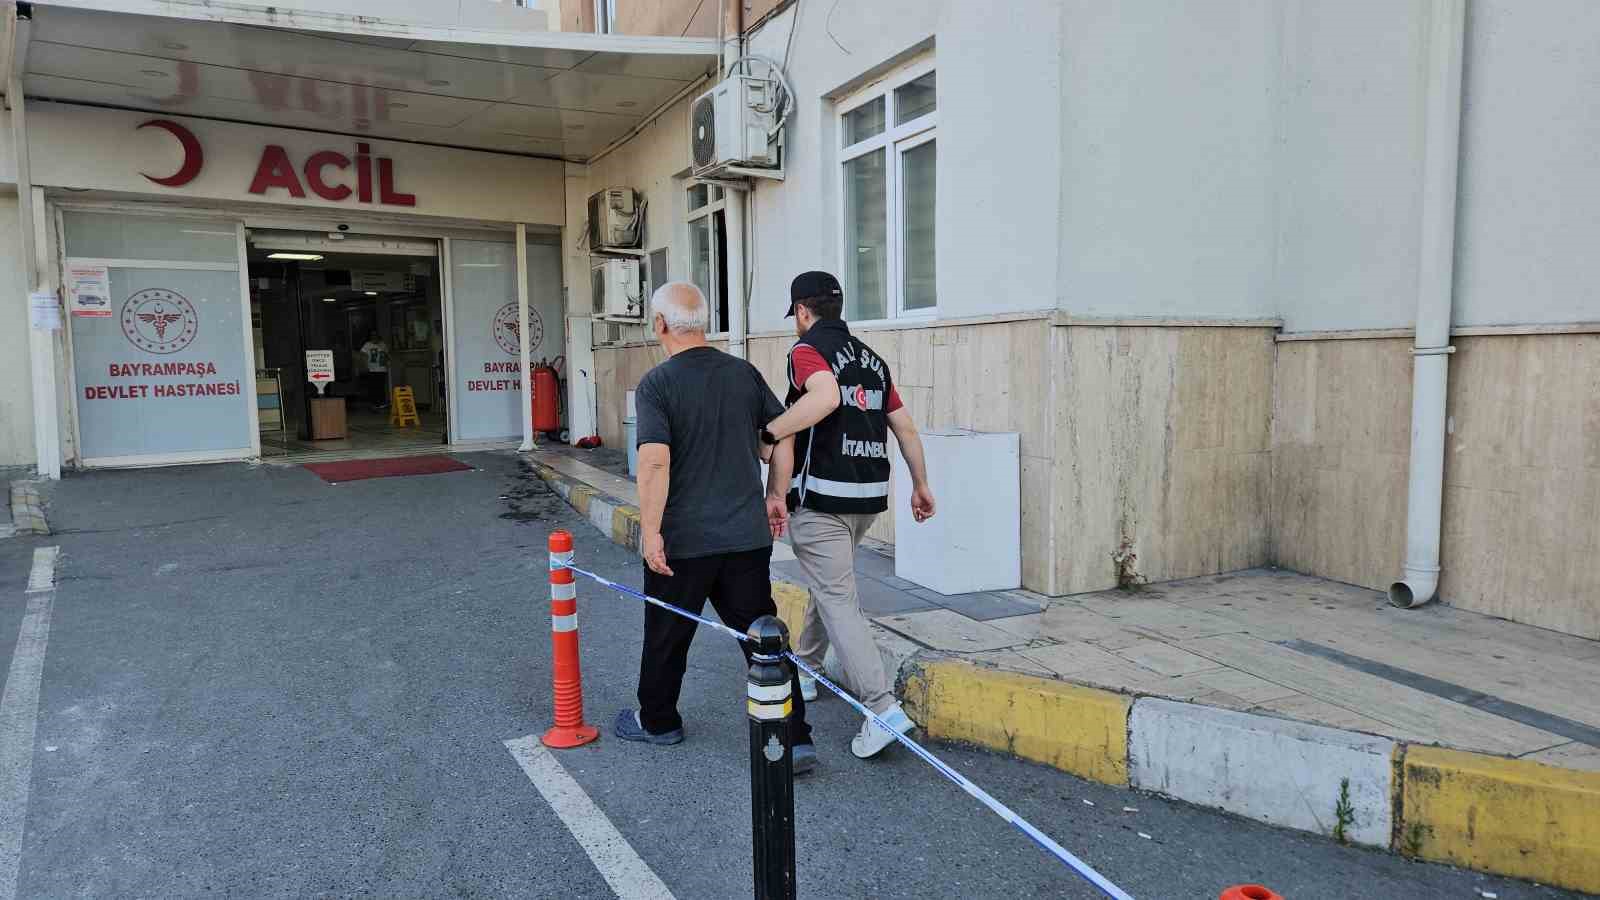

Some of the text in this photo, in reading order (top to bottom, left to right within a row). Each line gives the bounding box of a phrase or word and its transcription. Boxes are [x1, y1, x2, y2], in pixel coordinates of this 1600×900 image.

[248, 142, 416, 207] ACİL
[109, 361, 217, 378] BAYRAMPAŞA
[84, 379, 240, 400] DEVLET HASTANESİ
[468, 380, 510, 391] DEVLET
[842, 433, 888, 458] İTANBU
